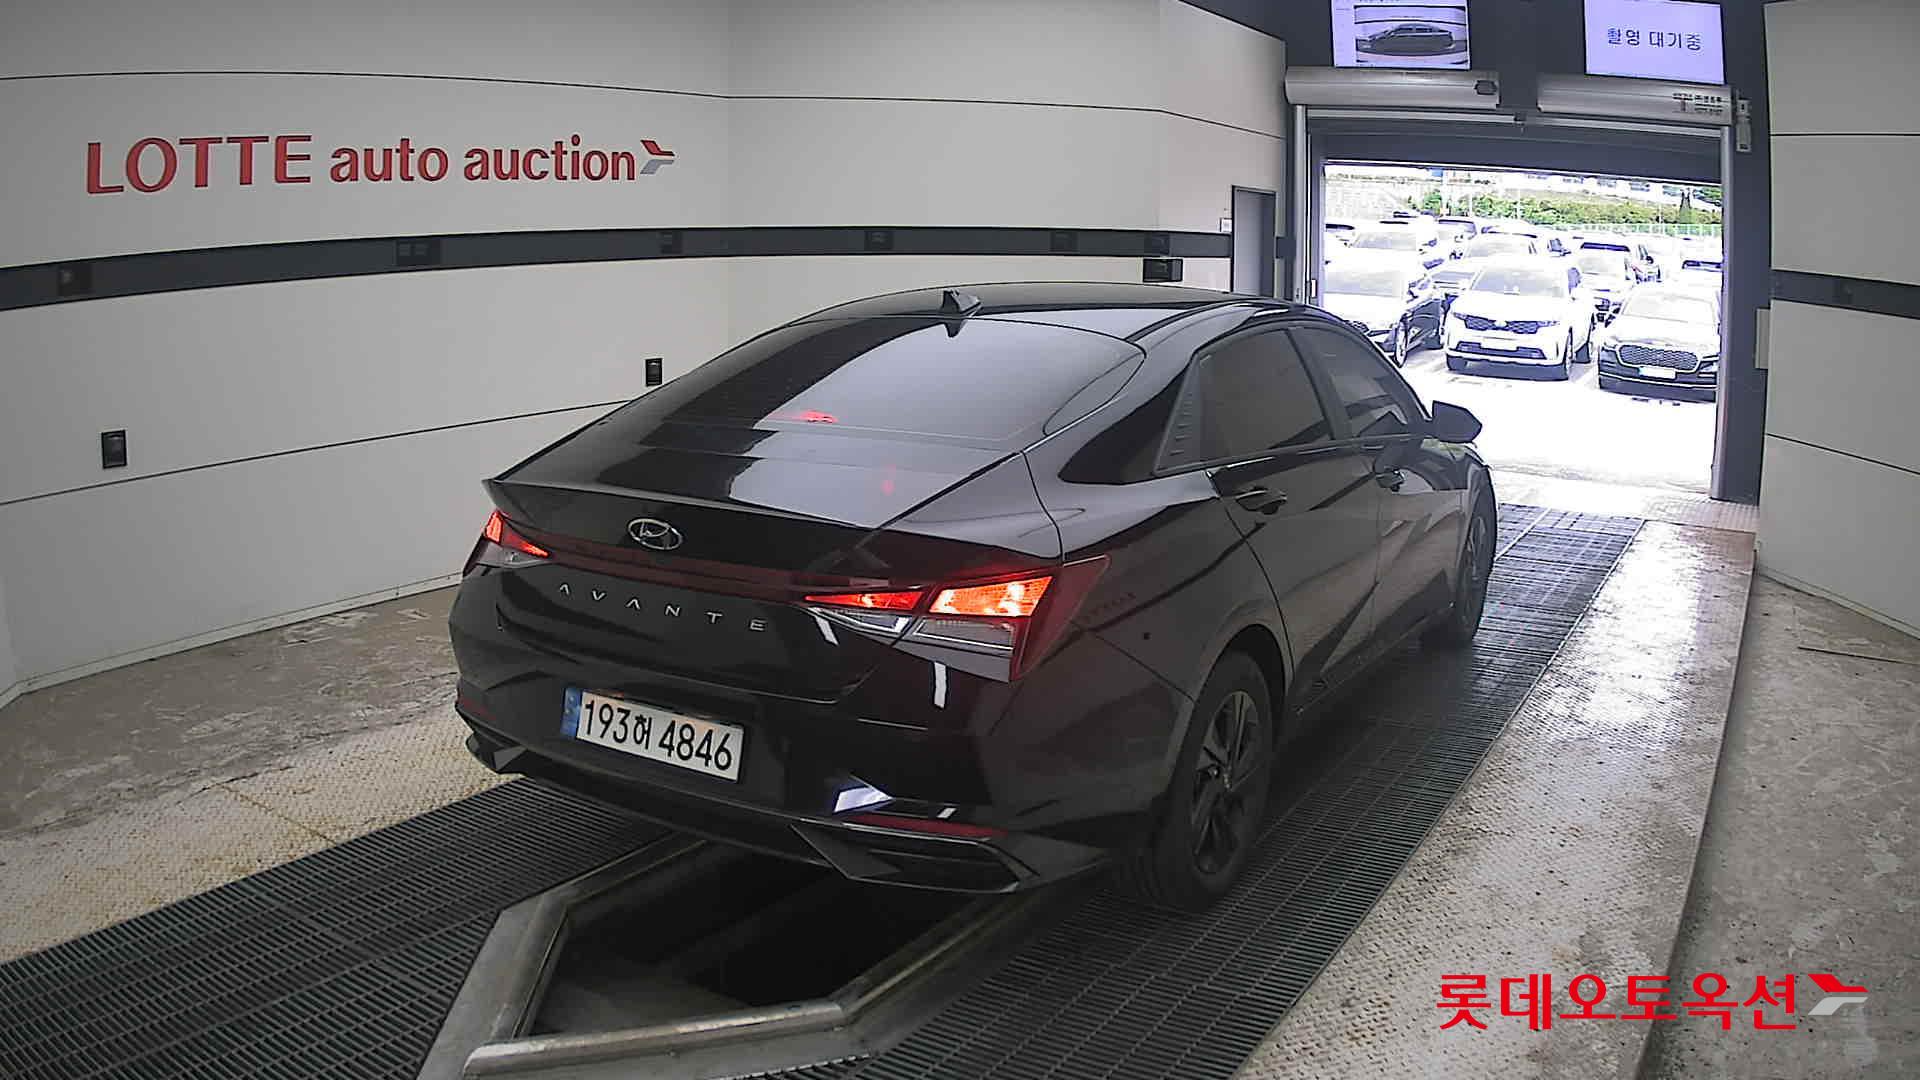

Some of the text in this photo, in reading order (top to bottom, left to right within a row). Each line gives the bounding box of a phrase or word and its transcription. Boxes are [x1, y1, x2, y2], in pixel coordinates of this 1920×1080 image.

[87, 134, 636, 194] LOTTE auto auction
[559, 583, 767, 631] AVANTE
[585, 700, 732, 771] 193허 4846
